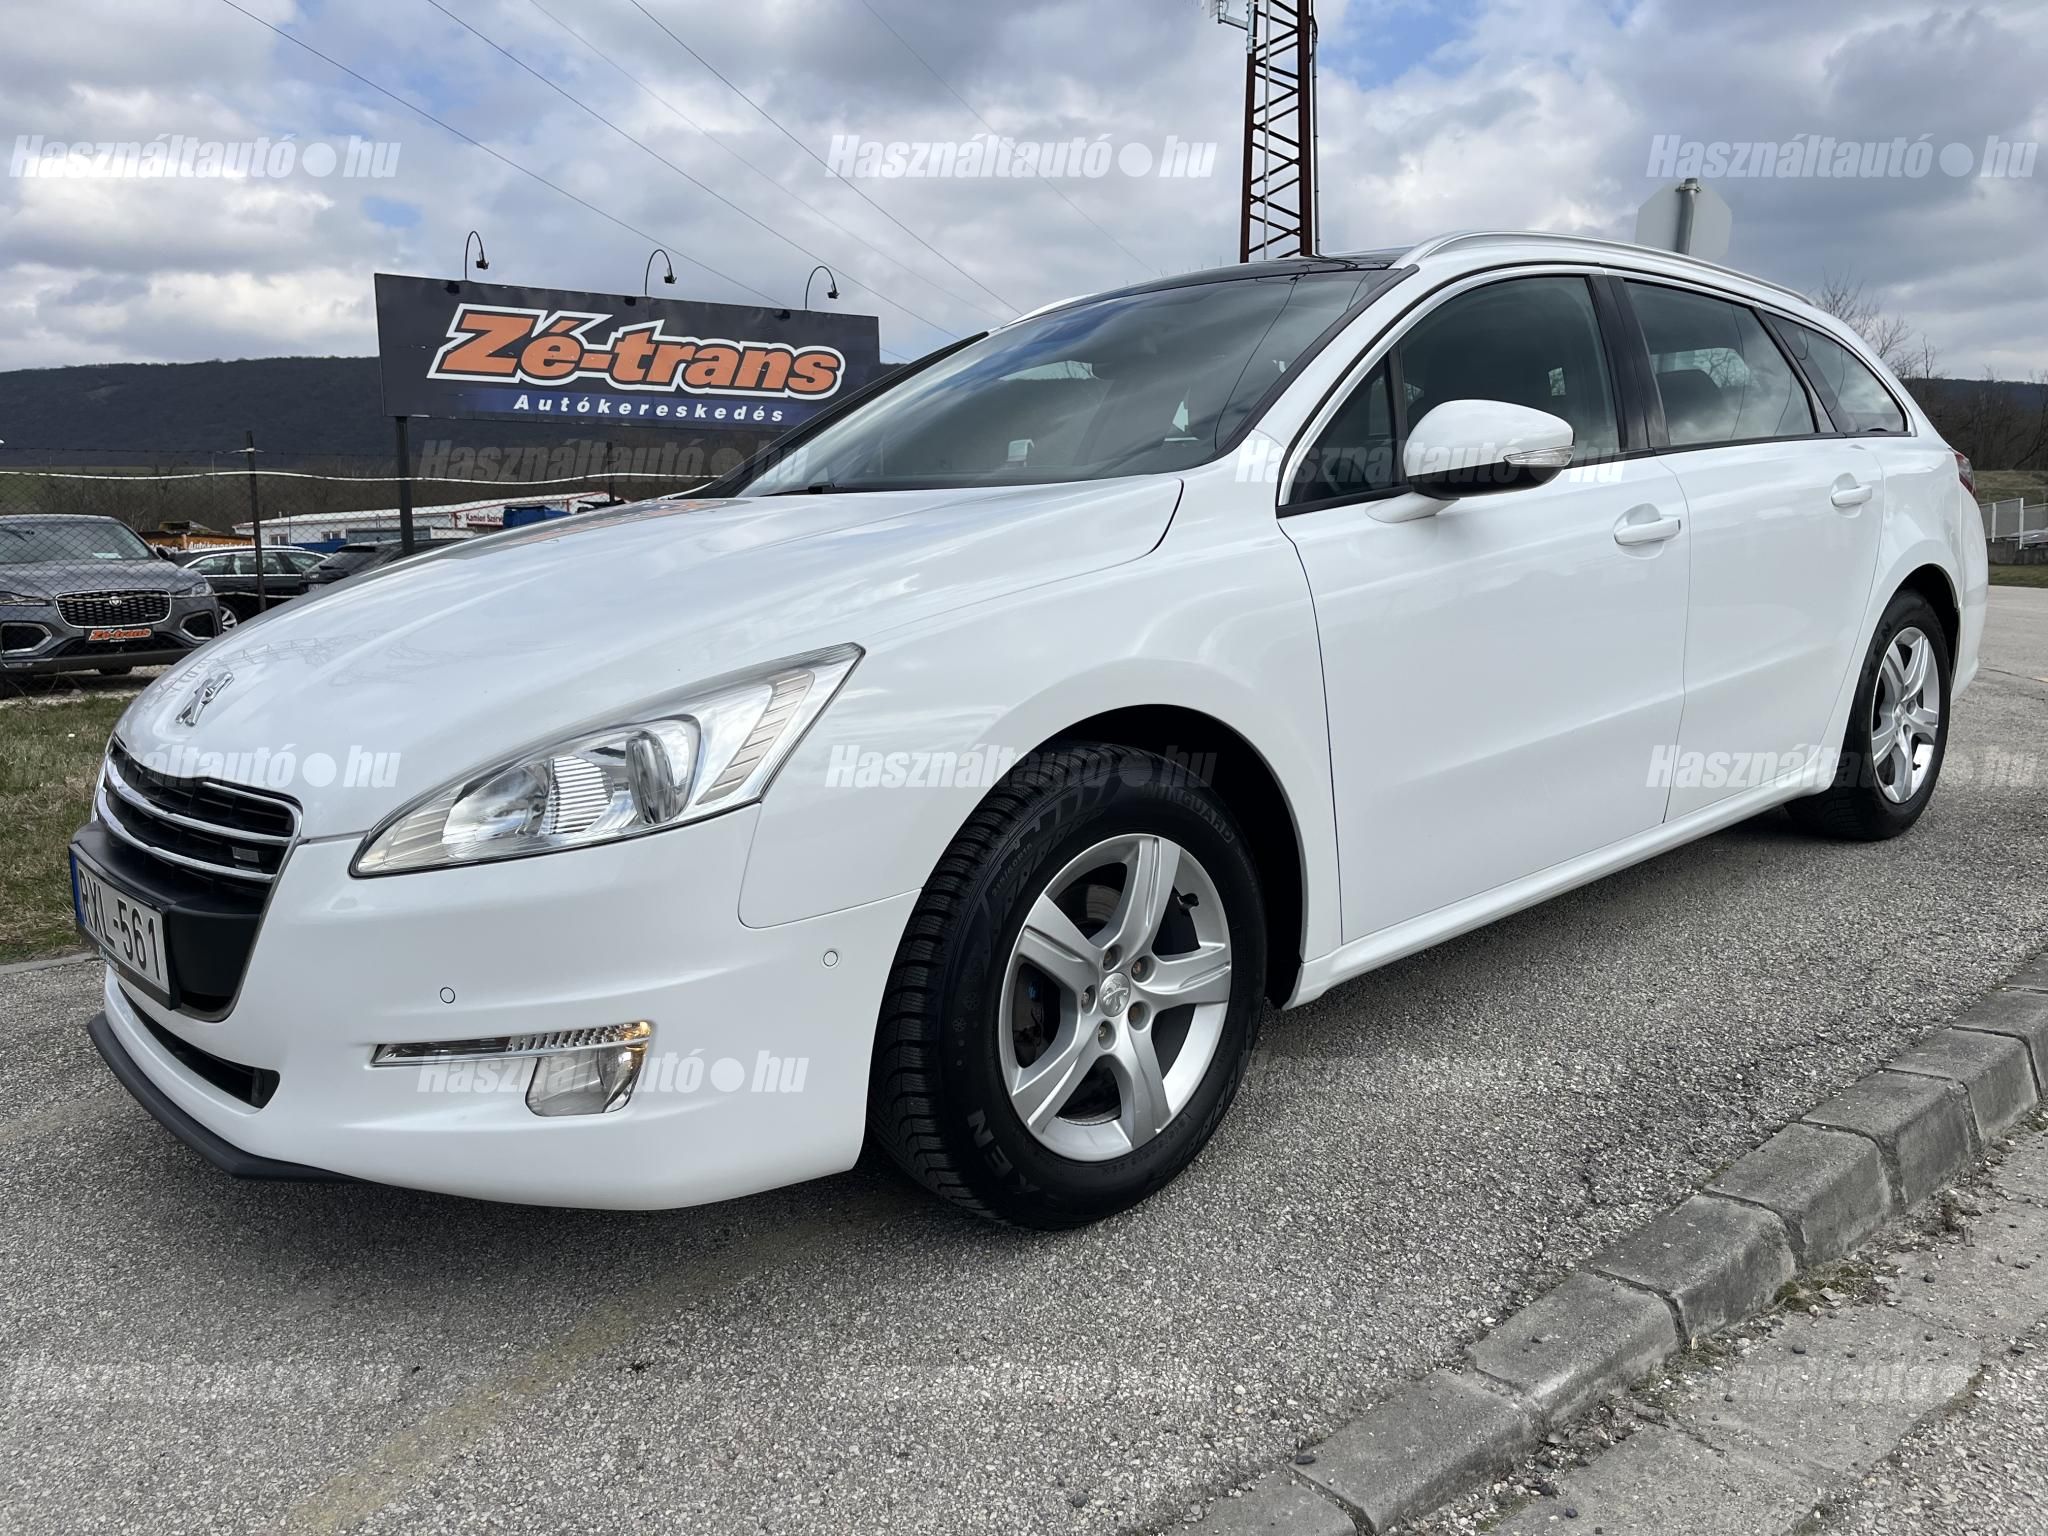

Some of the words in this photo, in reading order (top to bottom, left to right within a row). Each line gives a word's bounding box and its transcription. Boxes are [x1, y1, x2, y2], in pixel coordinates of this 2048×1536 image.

[430, 305, 844, 398] Zé-trans
[513, 394, 784, 423] Autókereskedés
[78, 867, 162, 982] RXL-561
